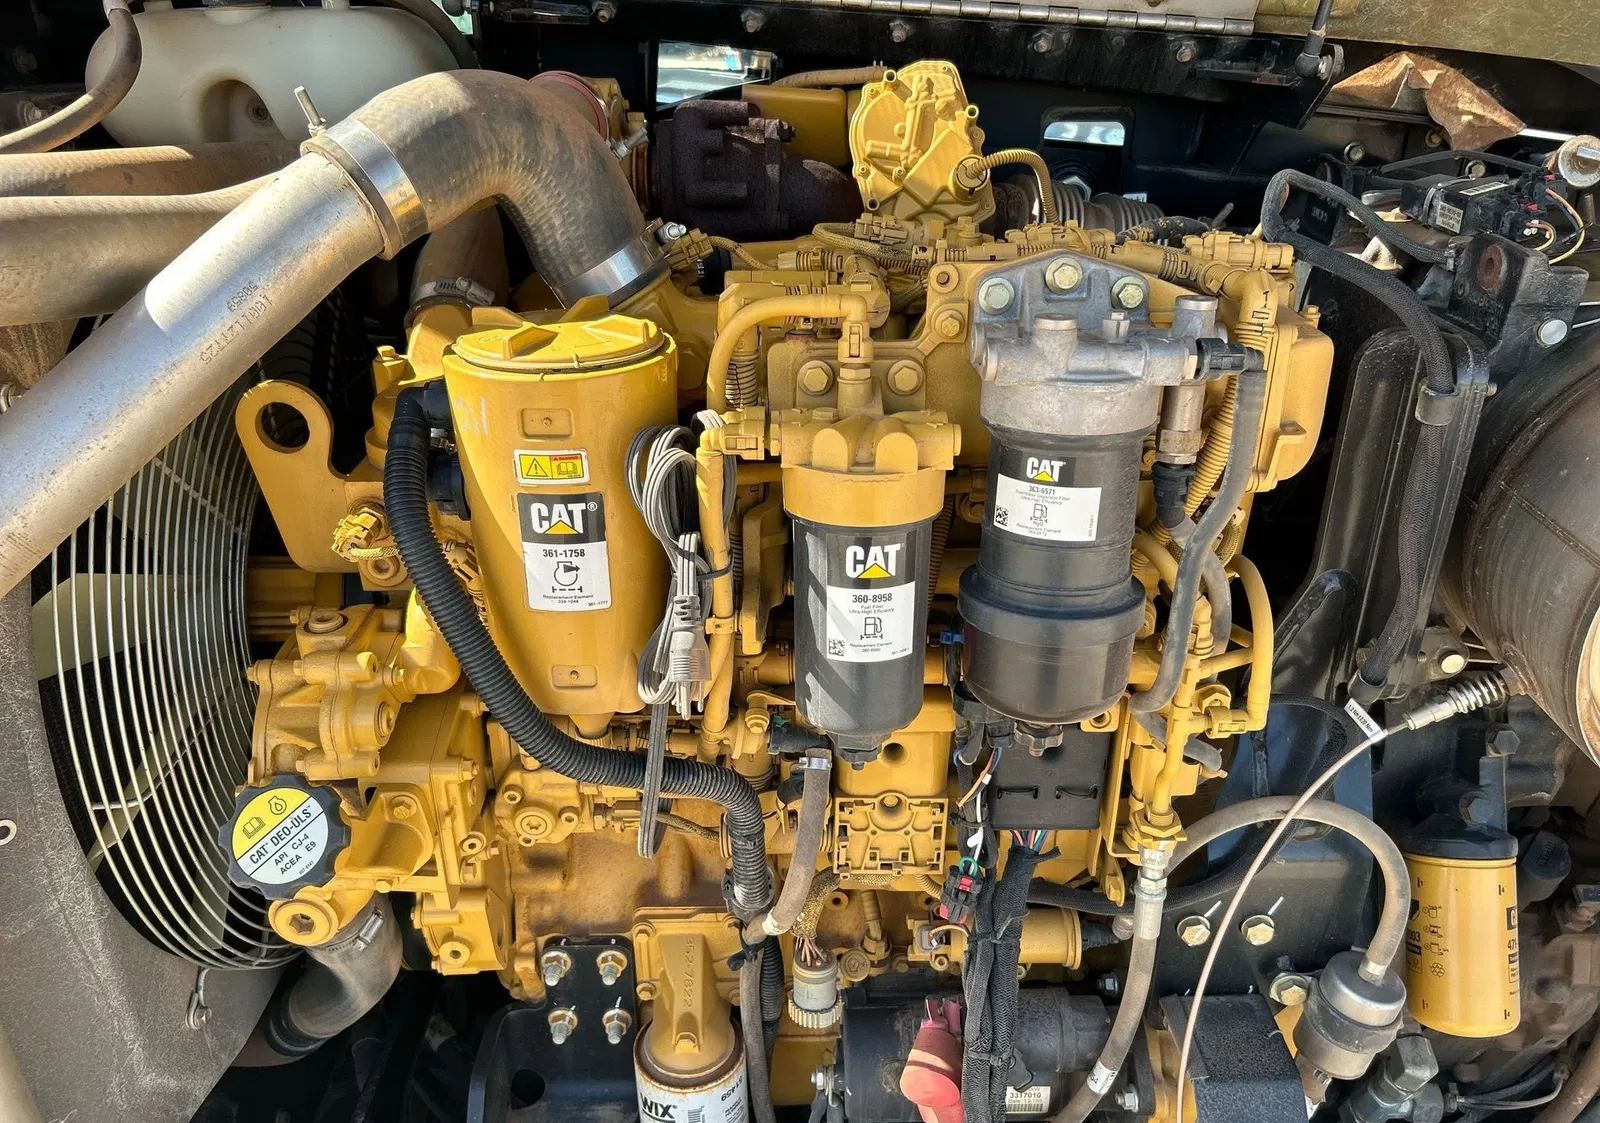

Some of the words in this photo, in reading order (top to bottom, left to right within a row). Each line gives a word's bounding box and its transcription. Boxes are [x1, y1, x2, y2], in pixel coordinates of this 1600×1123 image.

[1028, 485, 1056, 495] 363-6571
[542, 549, 586, 558] 361-1758
[852, 592, 893, 604] 360-8958
[274, 851, 289, 866] API
[291, 833, 310, 851] CJ-4
[280, 854, 303, 875] ACEA
[304, 841, 317, 852] E9
